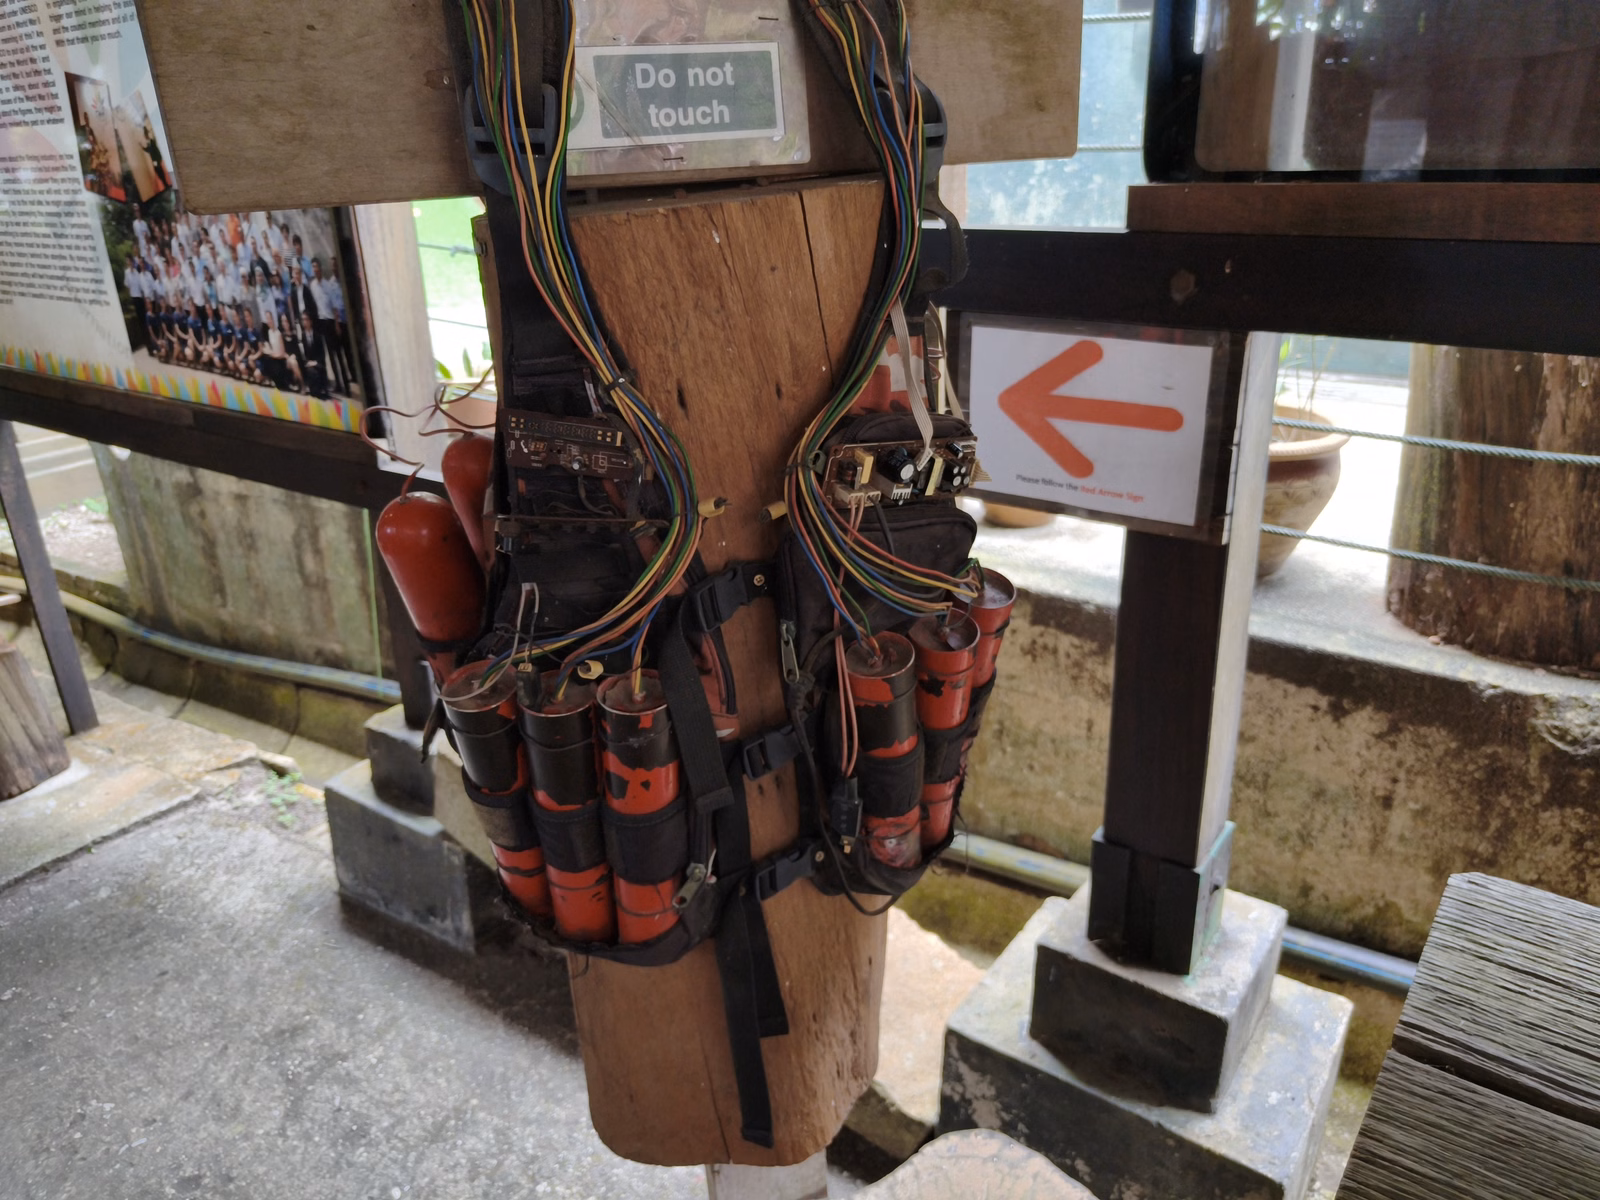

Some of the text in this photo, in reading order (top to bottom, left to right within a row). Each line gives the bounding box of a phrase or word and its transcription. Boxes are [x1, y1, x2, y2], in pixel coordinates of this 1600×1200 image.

[19, 4, 38, 15] UNESCO
[635, 62, 735, 89] Do not
[648, 99, 730, 128] touch
[1015, 474, 1144, 503] Please follow the Red Arrow Sign
